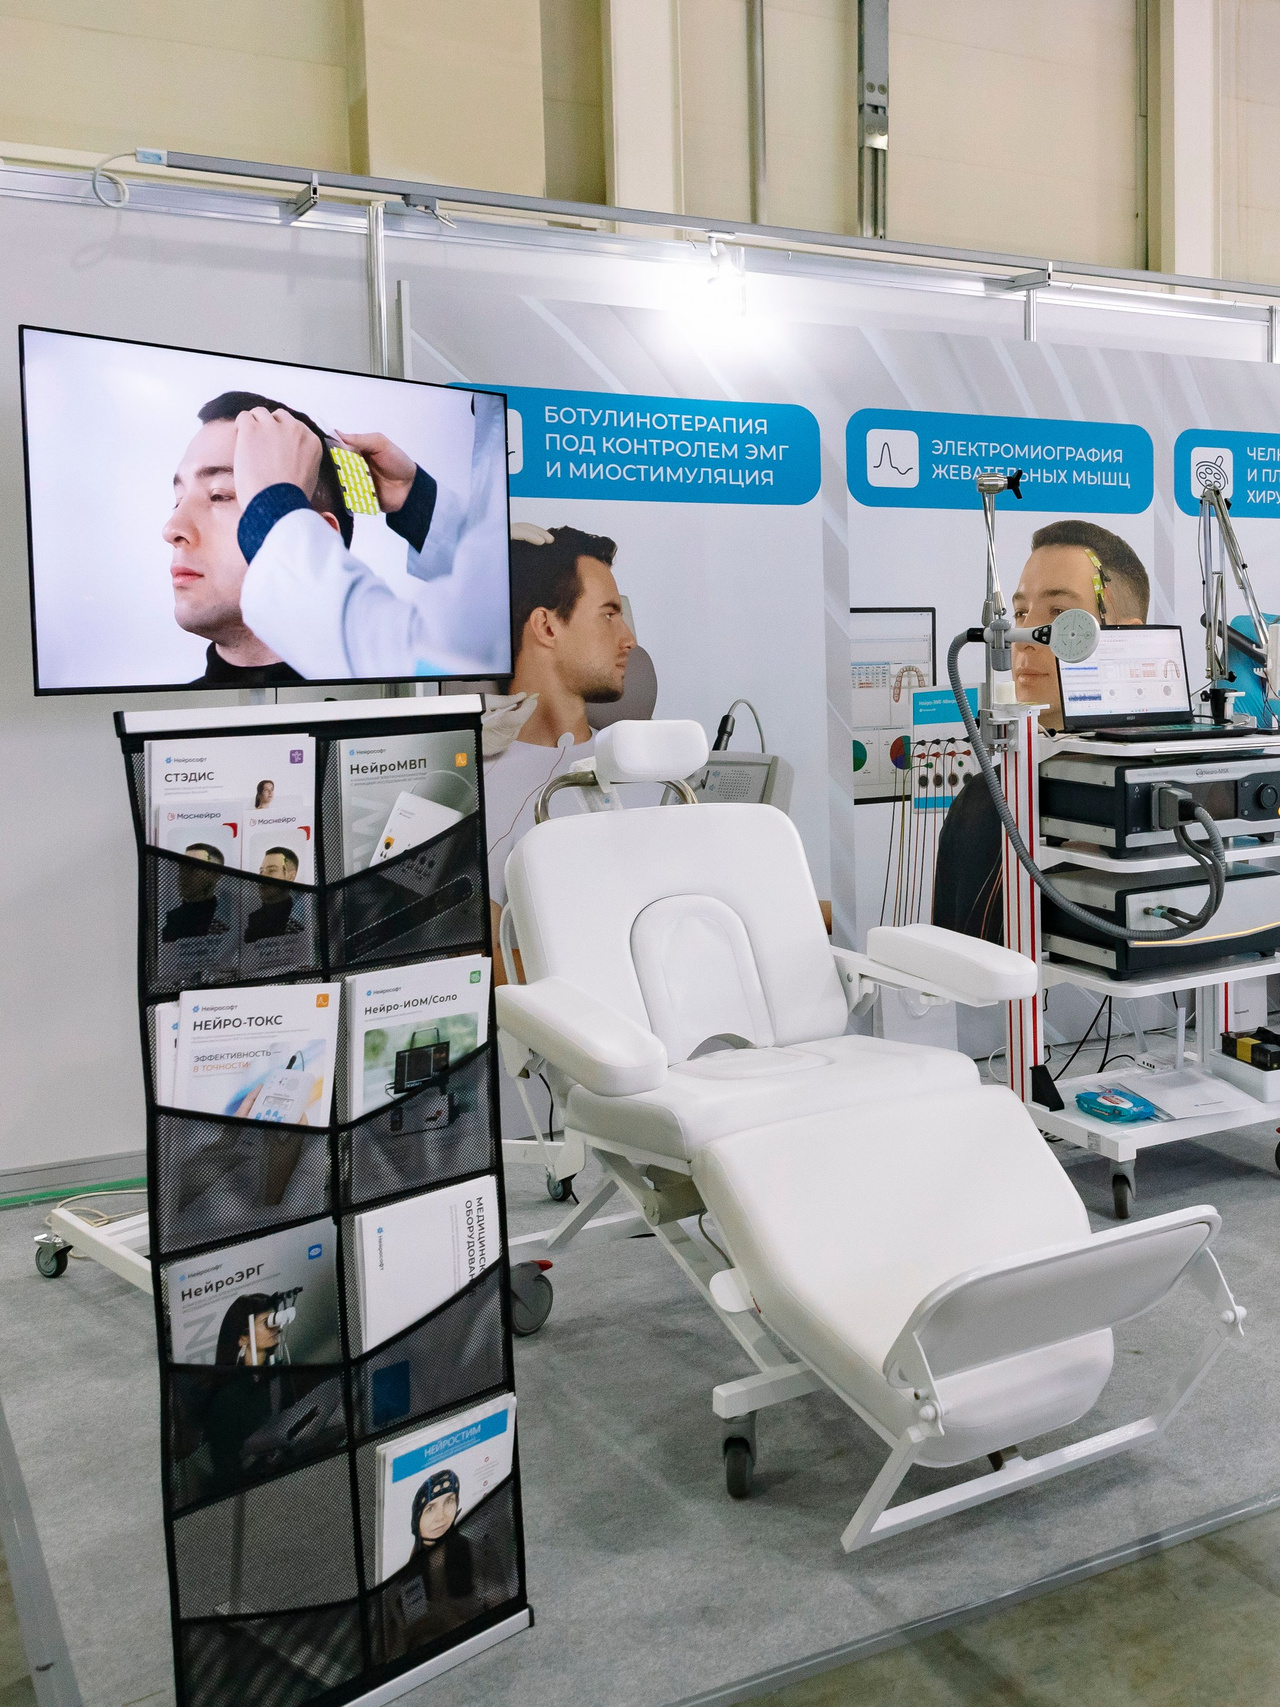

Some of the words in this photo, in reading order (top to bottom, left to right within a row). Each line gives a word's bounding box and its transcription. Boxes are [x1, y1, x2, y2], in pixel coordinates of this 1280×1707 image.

[544, 405, 768, 435] БОТУЛИНОТЕРАПИЯ
[545, 433, 596, 456] ПОД
[602, 437, 739, 460] КОНТРОЛЕМ
[744, 443, 789, 462] ЭМГ
[931, 439, 1123, 464] ЭЛЕКТРОМИОГРАФИЯ
[546, 461, 562, 479] И
[569, 462, 774, 488] МИОСТИМУЛЯЦИЯ
[1072, 469, 1131, 489] МЫШЦ
[1247, 468, 1257, 482] И
[164, 771, 215, 783] СТЭДИС
[350, 758, 427, 775] НейроМВП
[177, 811, 222, 820] Моснейро
[258, 816, 297, 825] Моснейро
[364, 993, 458, 1016] Нейро-ИОМ/Соло
[193, 1014, 283, 1031] НЕЙРО-ТОКС
[193, 1050, 272, 1063] ЭФФЕКТИВНОСТЬ
[202, 1061, 250, 1072] ТОЧНОСТИ
[464, 1199, 476, 1281] ОБОРУДОВАН
[475, 1196, 487, 1273] МЕДИЦИНСК
[181, 1263, 265, 1302] НейроЭРГ
[424, 1424, 482, 1458] НЕЙРОСТИМ
